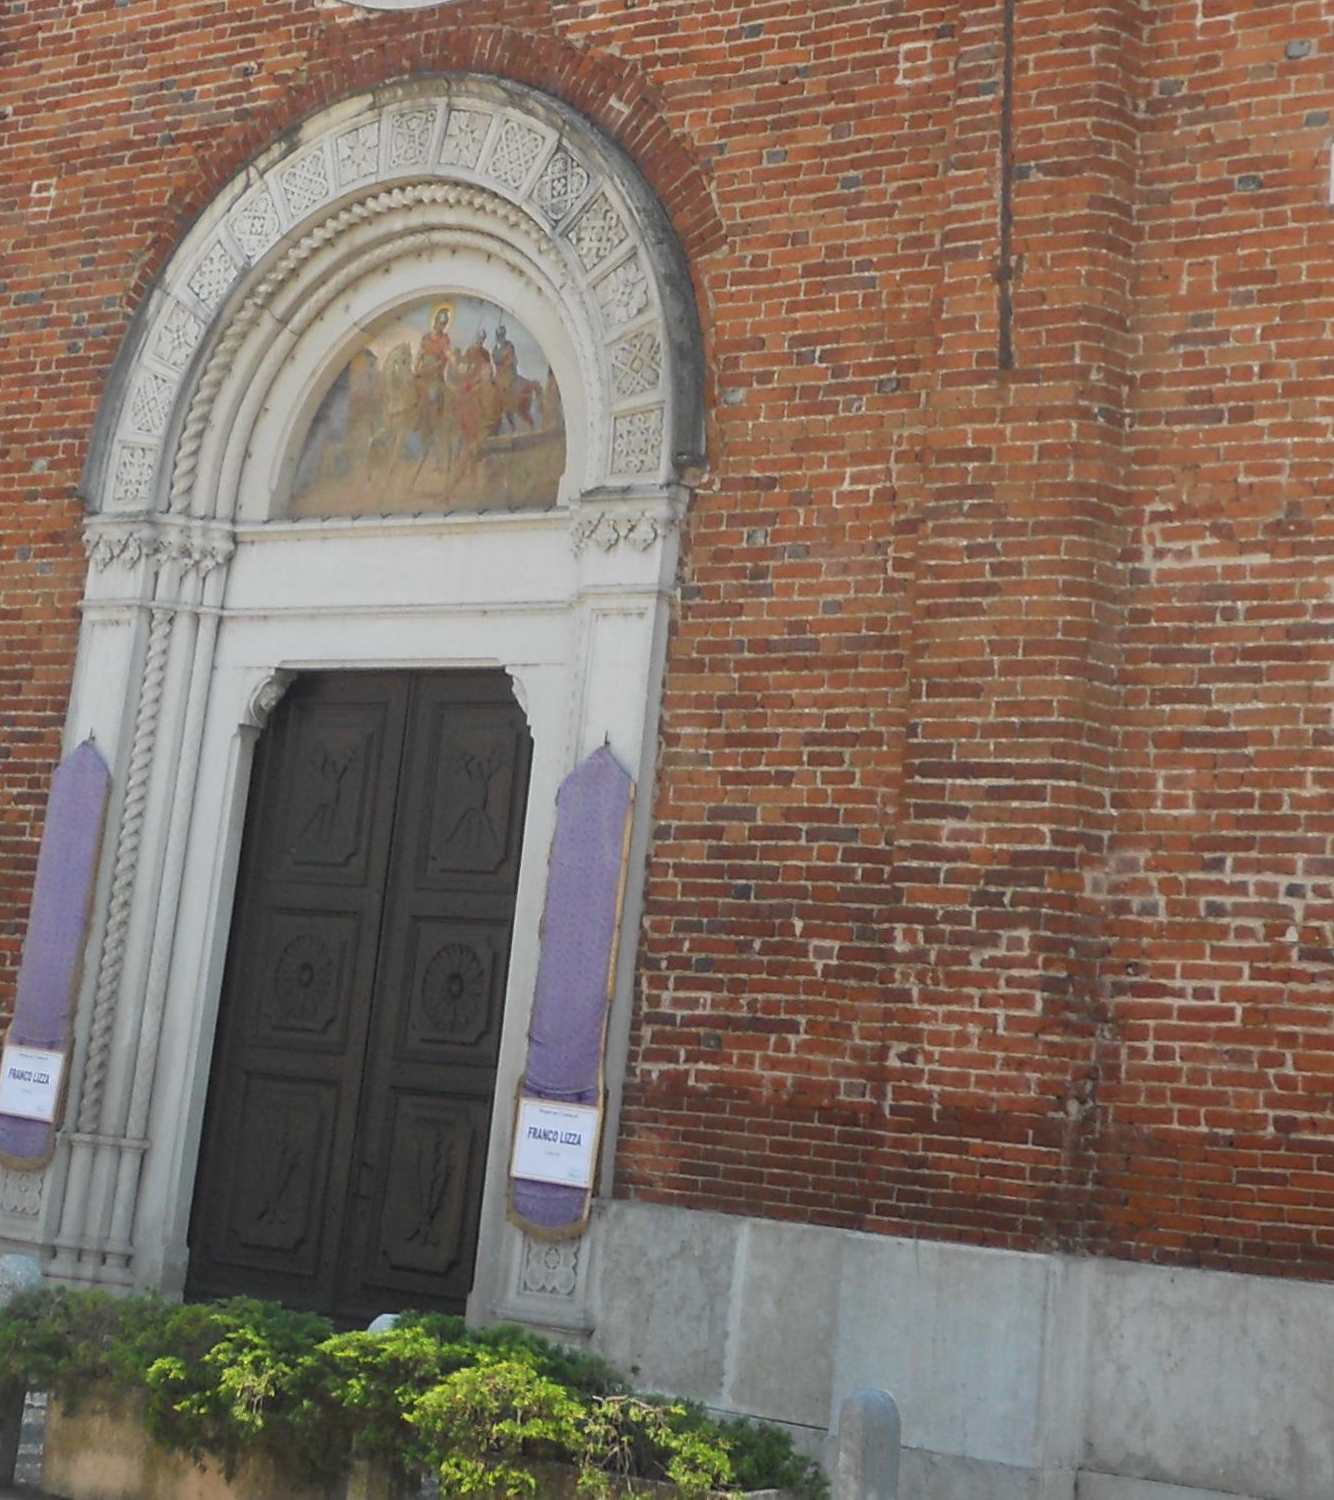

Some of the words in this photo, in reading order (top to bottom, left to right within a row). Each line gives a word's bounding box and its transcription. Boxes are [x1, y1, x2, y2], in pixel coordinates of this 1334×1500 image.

[8, 1067, 33, 1082] FRANCO
[33, 1071, 50, 1085] LIZZA
[528, 1126, 559, 1143] FRANCO
[560, 1131, 582, 1147] LIZZA
